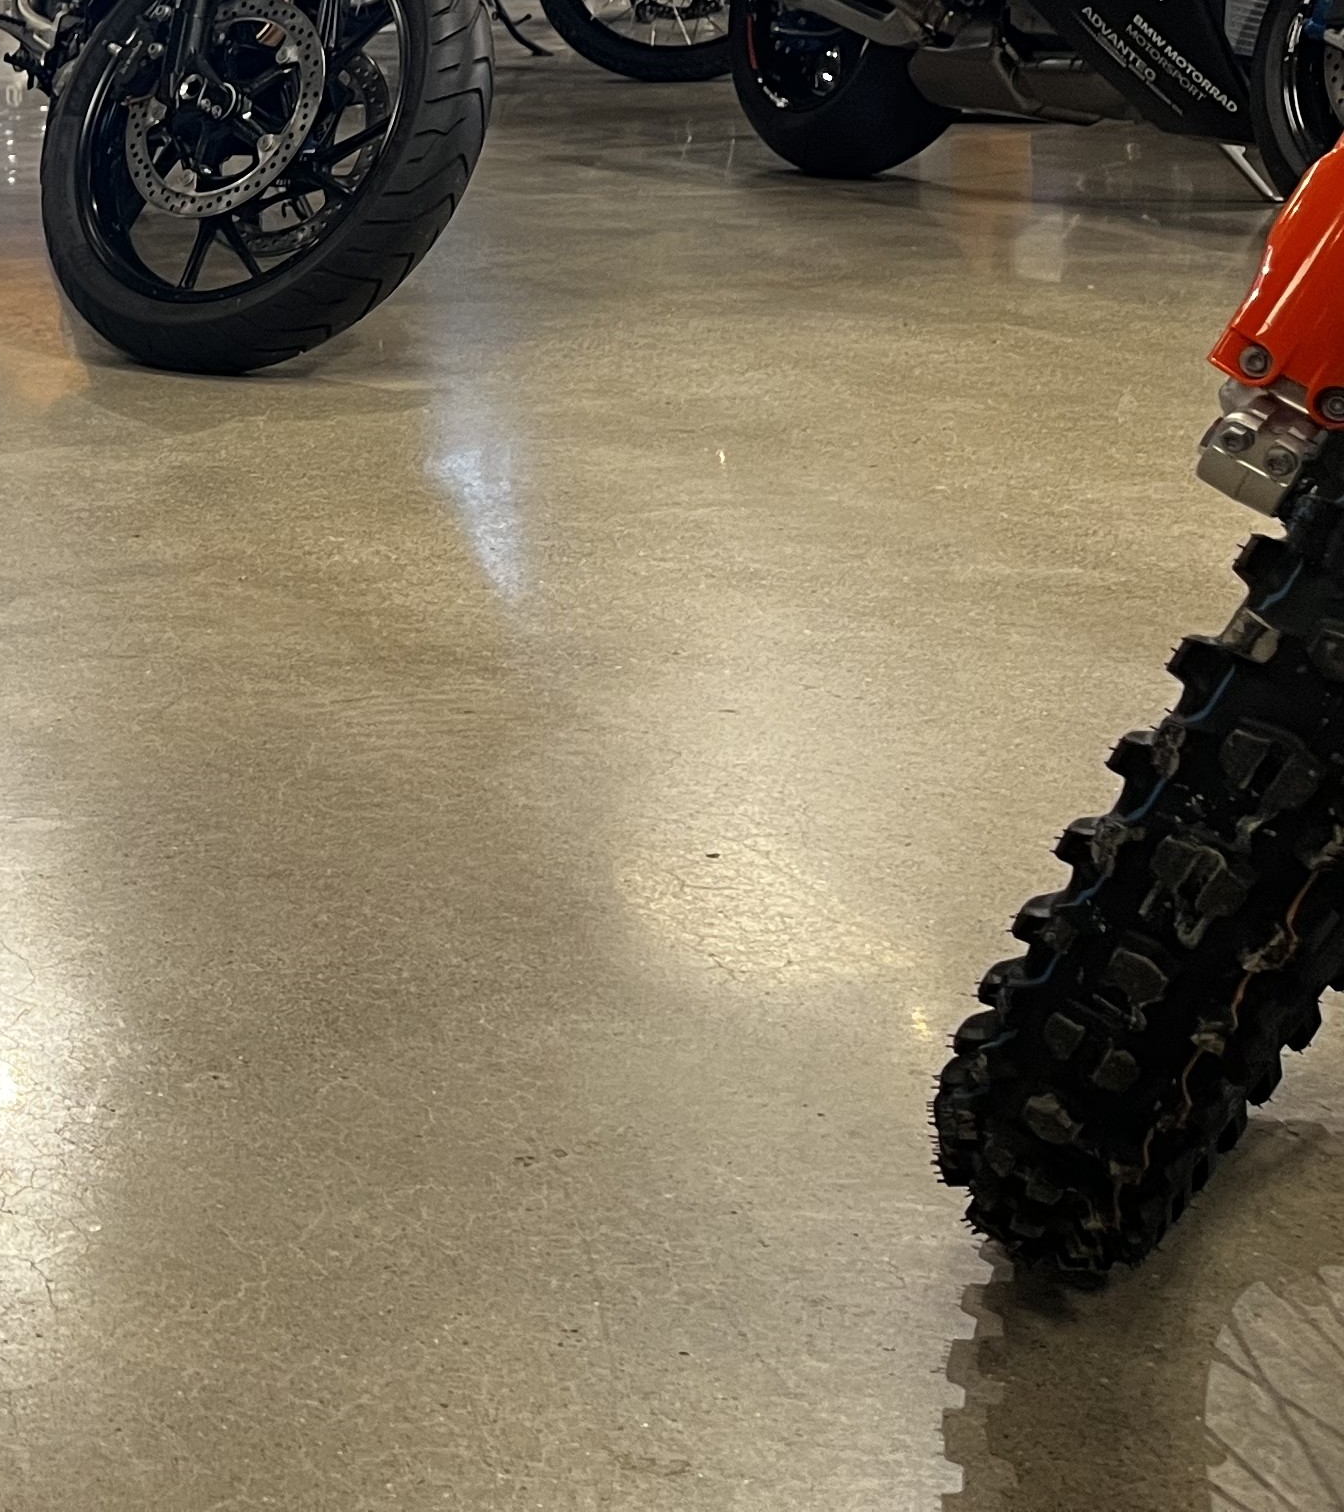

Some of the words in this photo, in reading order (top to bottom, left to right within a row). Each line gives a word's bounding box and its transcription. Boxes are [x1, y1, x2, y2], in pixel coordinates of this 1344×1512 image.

[1125, 24, 1205, 102] MOTORSPORT
[1132, 14, 1166, 48] BMW
[1163, 44, 1238, 113] MOTORRAD
